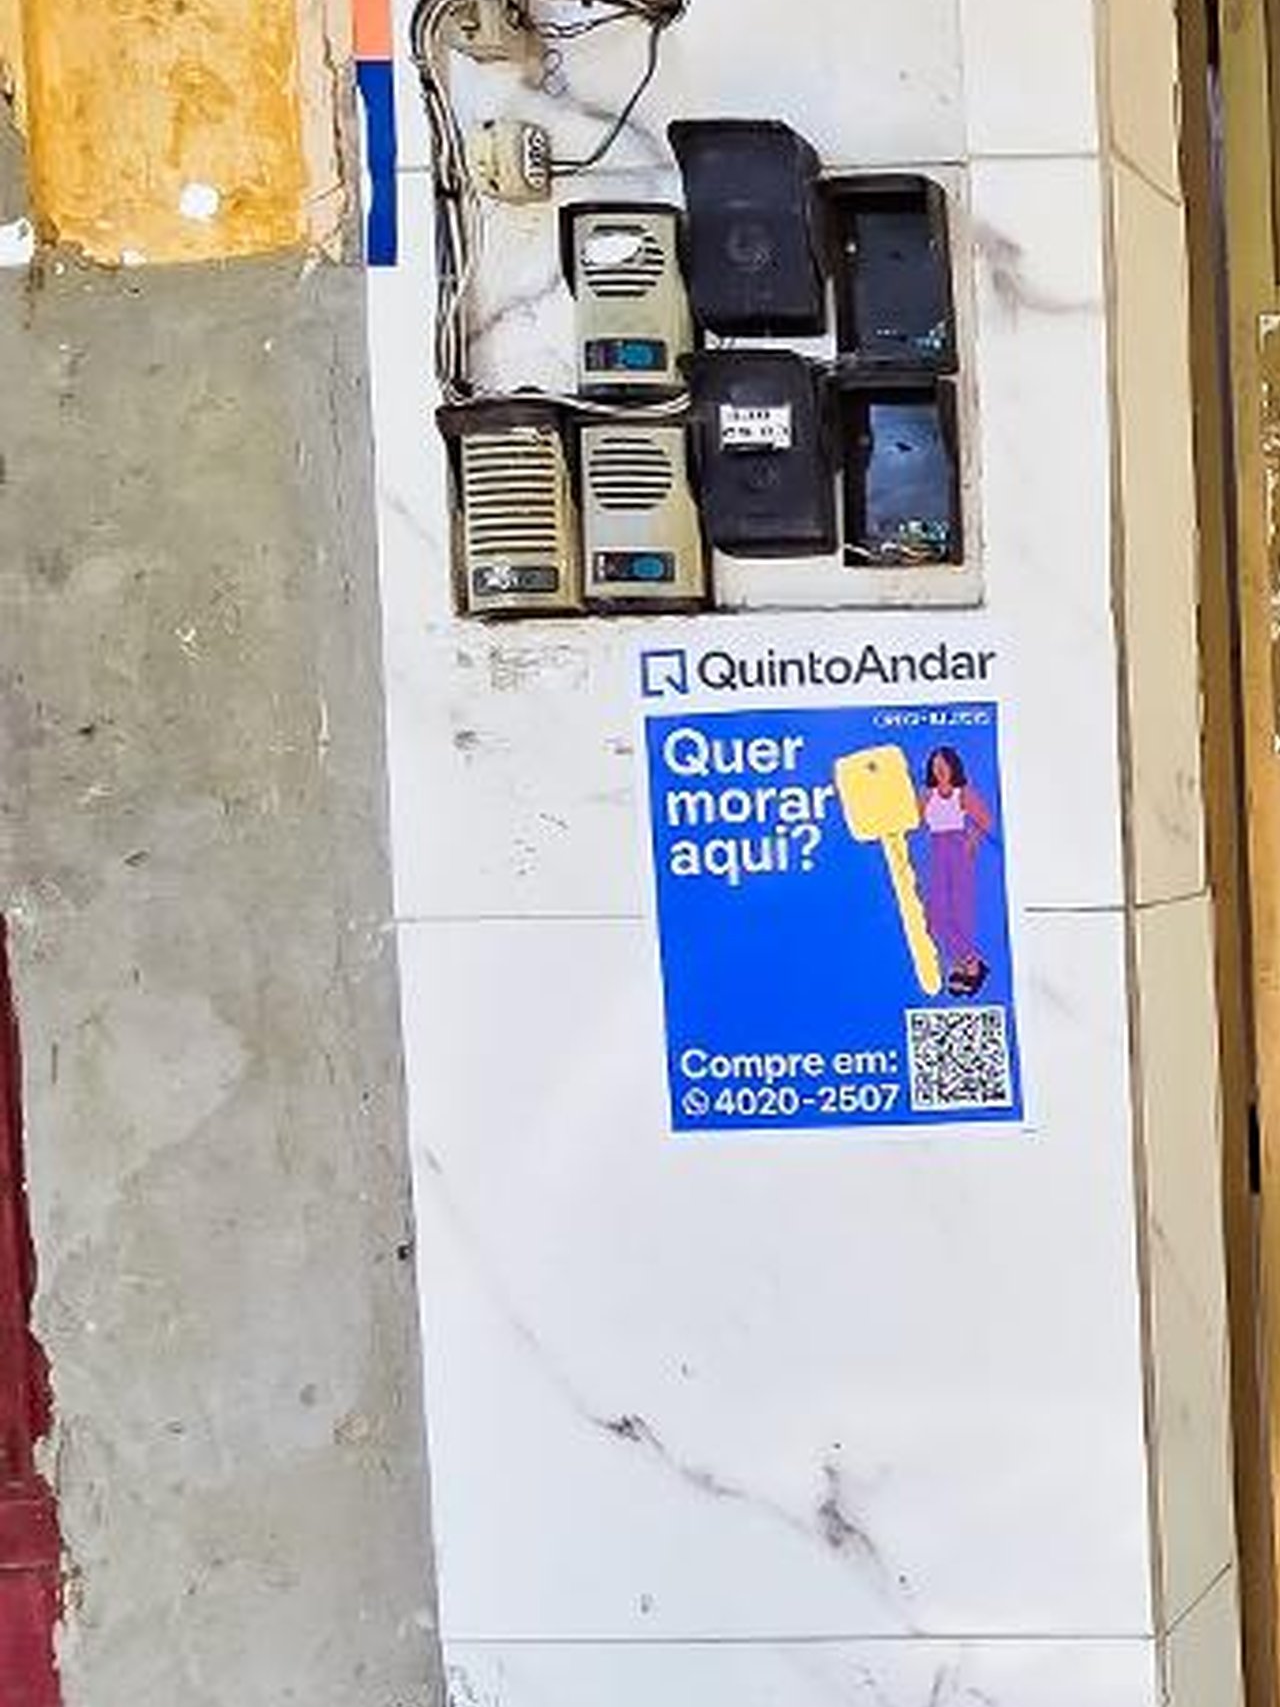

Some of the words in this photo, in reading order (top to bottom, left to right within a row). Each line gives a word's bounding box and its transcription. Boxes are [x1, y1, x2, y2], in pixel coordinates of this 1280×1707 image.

[697, 643, 996, 692] QuintoAndar
[663, 727, 804, 776] Quer
[666, 786, 836, 826] morar
[670, 824, 822, 886] aqui?
[680, 1049, 824, 1084] Compre
[833, 1050, 898, 1074] em:
[714, 1084, 900, 1115] 4020-2507
